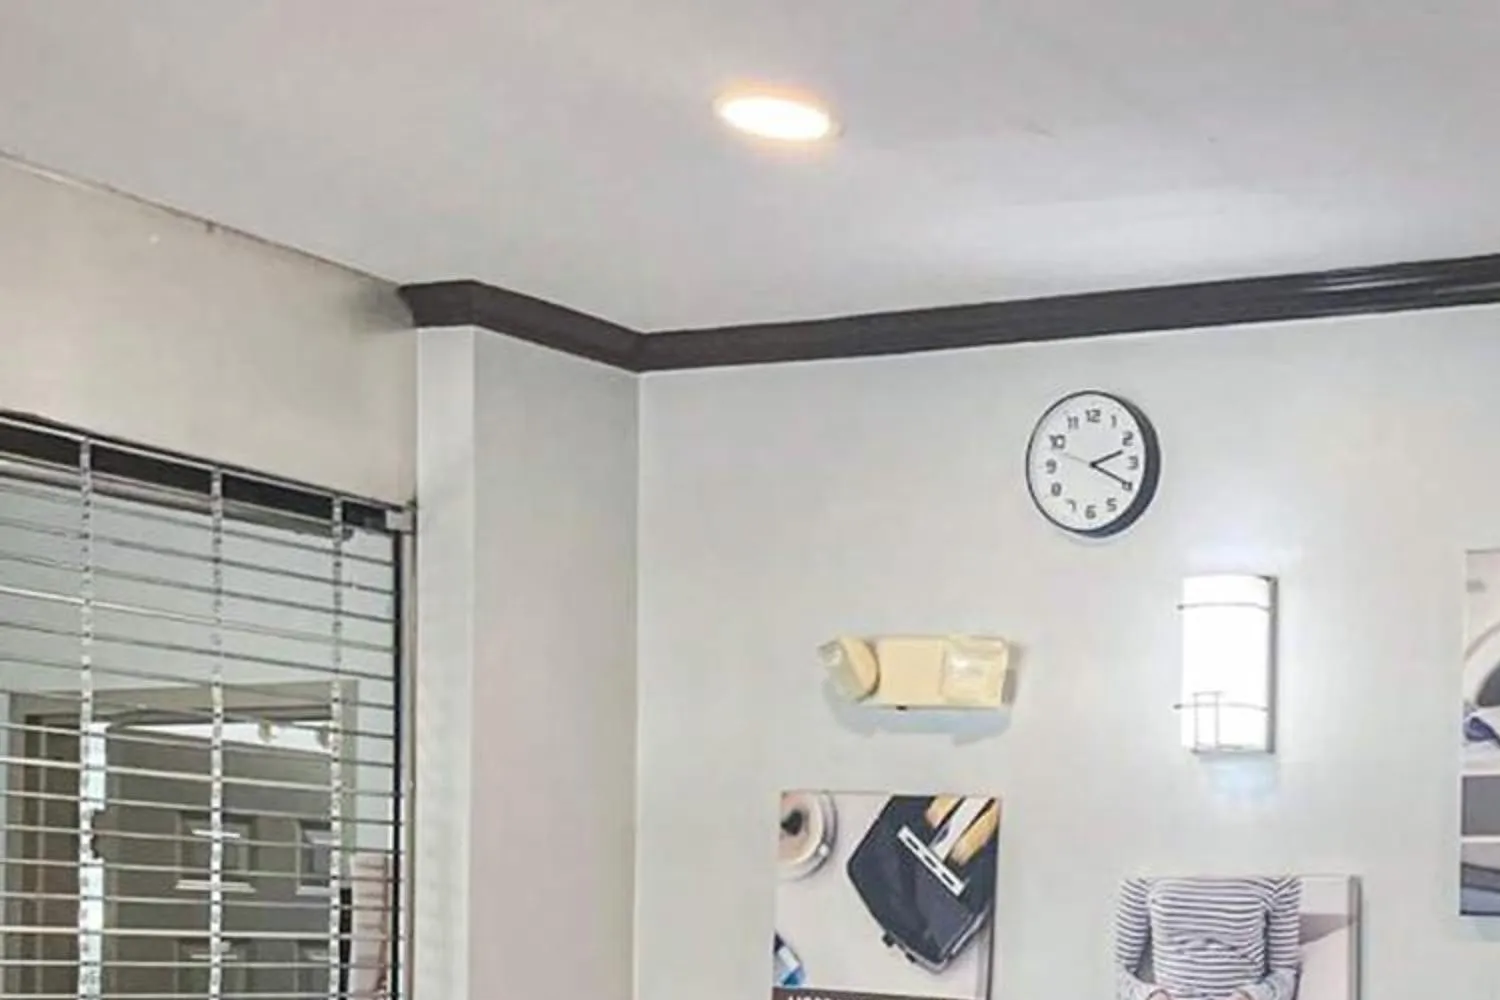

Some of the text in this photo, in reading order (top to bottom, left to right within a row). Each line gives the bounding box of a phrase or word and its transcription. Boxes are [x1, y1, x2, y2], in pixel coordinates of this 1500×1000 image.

[1067, 416, 1079, 430] 11
[1086, 410, 1101, 423] 12
[1111, 415, 1117, 428] 1
[1050, 434, 1066, 449] 10
[1122, 431, 1133, 446] 2
[1046, 458, 1057, 474] 9
[1128, 456, 1139, 470] 3
[1106, 498, 1117, 512] 5
[1085, 505, 1096, 520] 6
